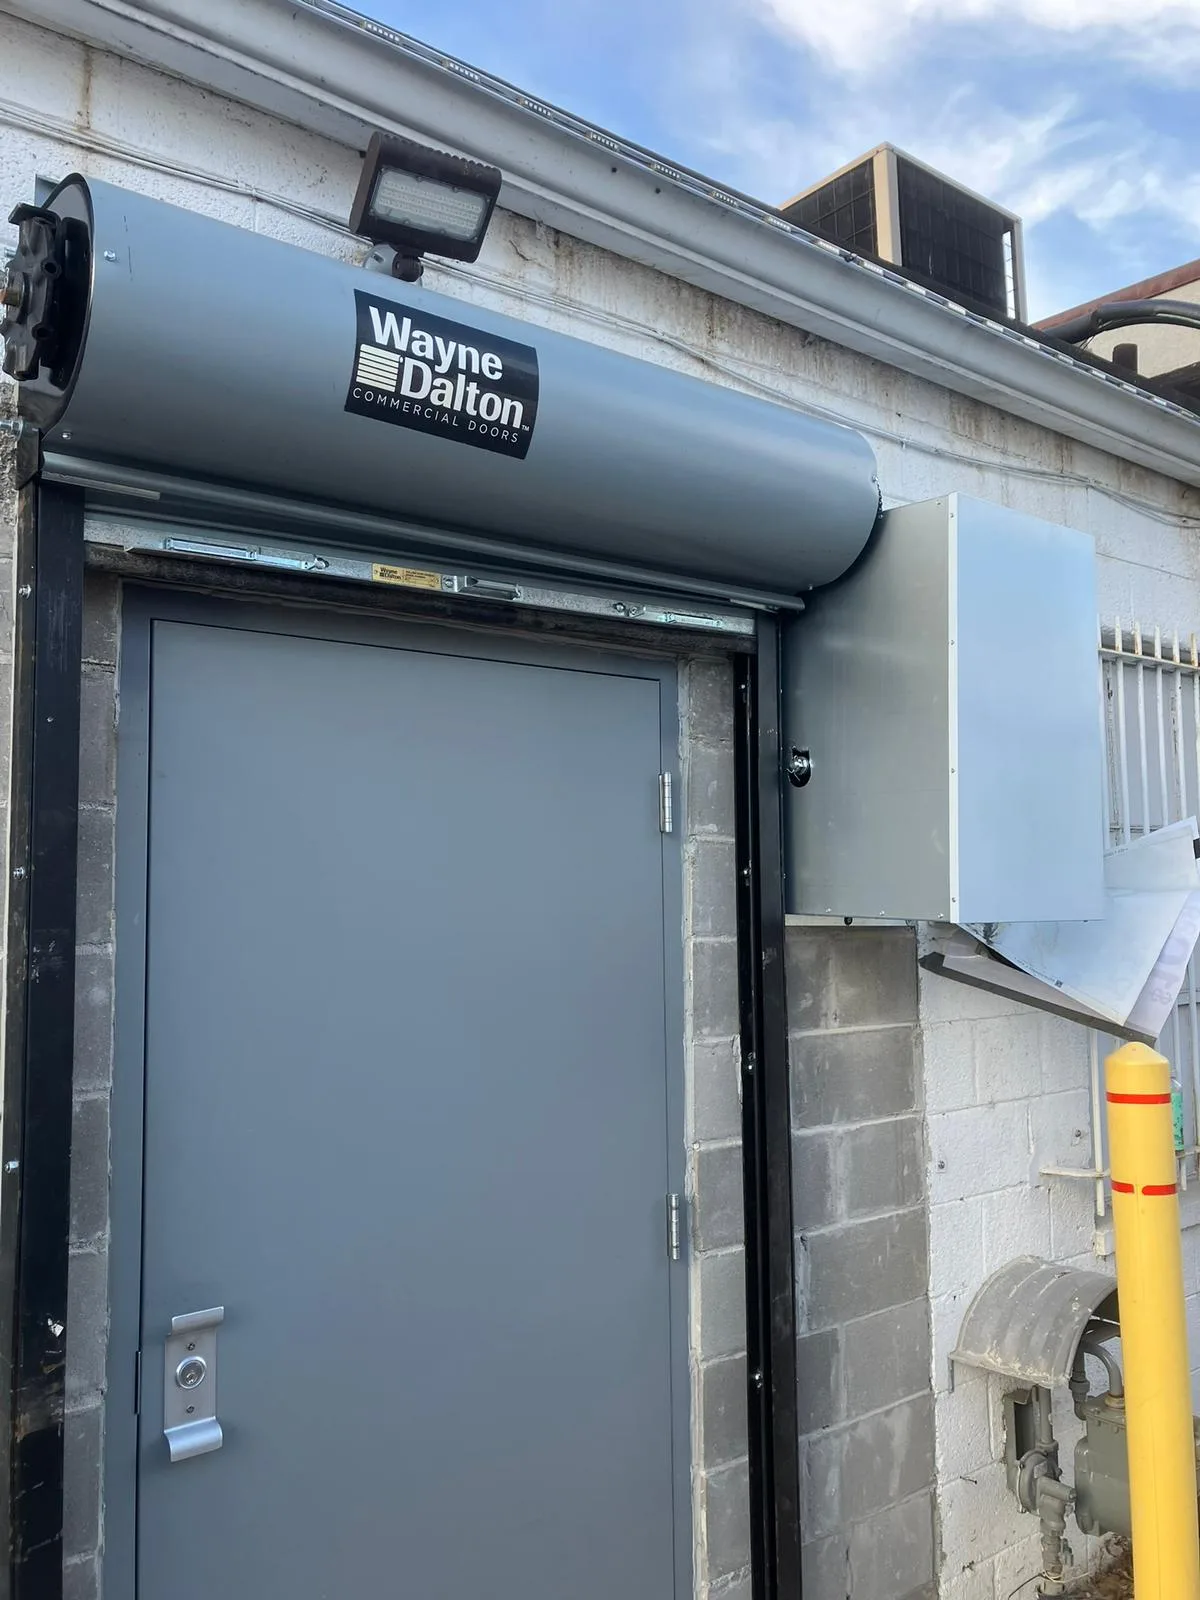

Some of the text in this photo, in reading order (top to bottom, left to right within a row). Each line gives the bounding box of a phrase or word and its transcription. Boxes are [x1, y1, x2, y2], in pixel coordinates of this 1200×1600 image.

[369, 305, 503, 380] Wayne
[352, 387, 519, 443] COMMERCIAL DOORS
[400, 356, 524, 429] Dalton
